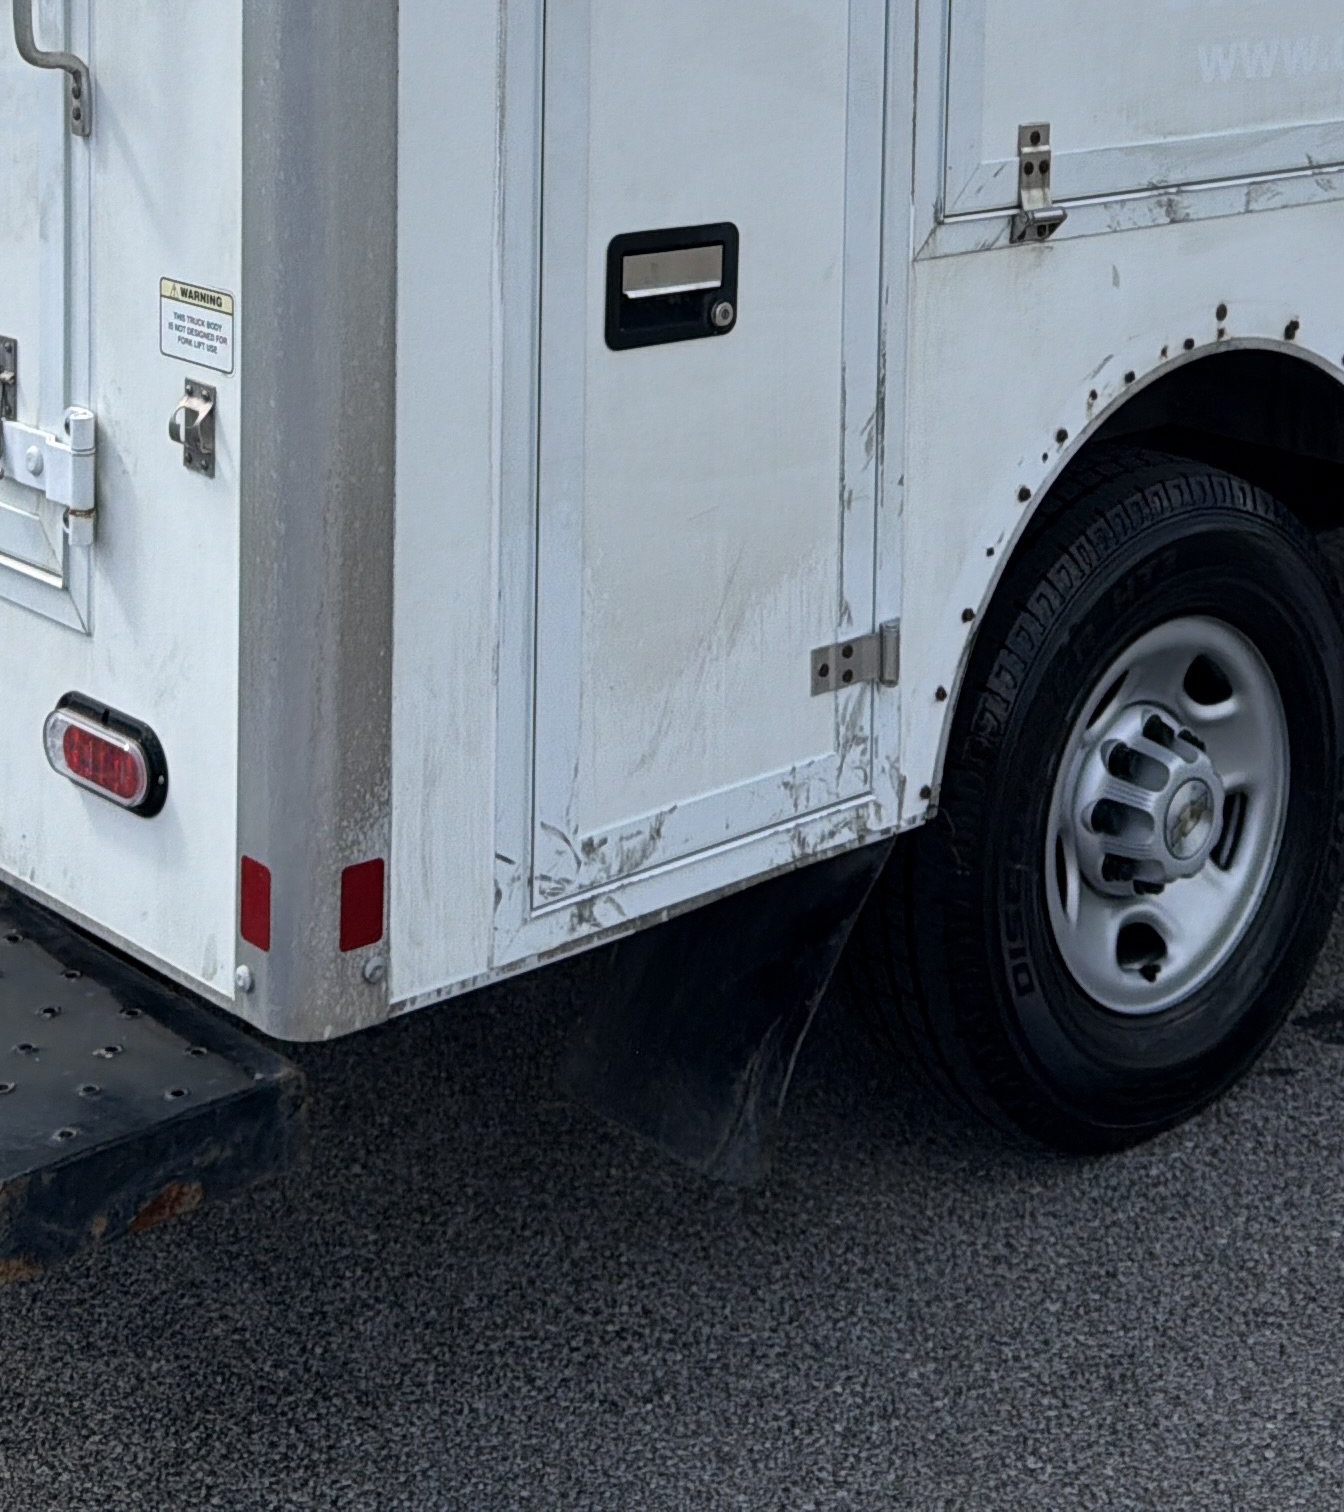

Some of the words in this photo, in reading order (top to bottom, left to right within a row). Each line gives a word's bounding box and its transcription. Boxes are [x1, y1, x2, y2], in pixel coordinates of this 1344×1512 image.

[180, 286, 223, 308] WARNING
[173, 311, 186, 323] THIS
[187, 315, 205, 328] TRUCK
[206, 320, 222, 333] BODY
[168, 322, 174, 331] IS
[174, 324, 186, 334] NOT
[187, 327, 215, 342] DESIGNED
[216, 334, 228, 345] FOR
[178, 335, 193, 347] FORK
[194, 341, 206, 351] LIFT
